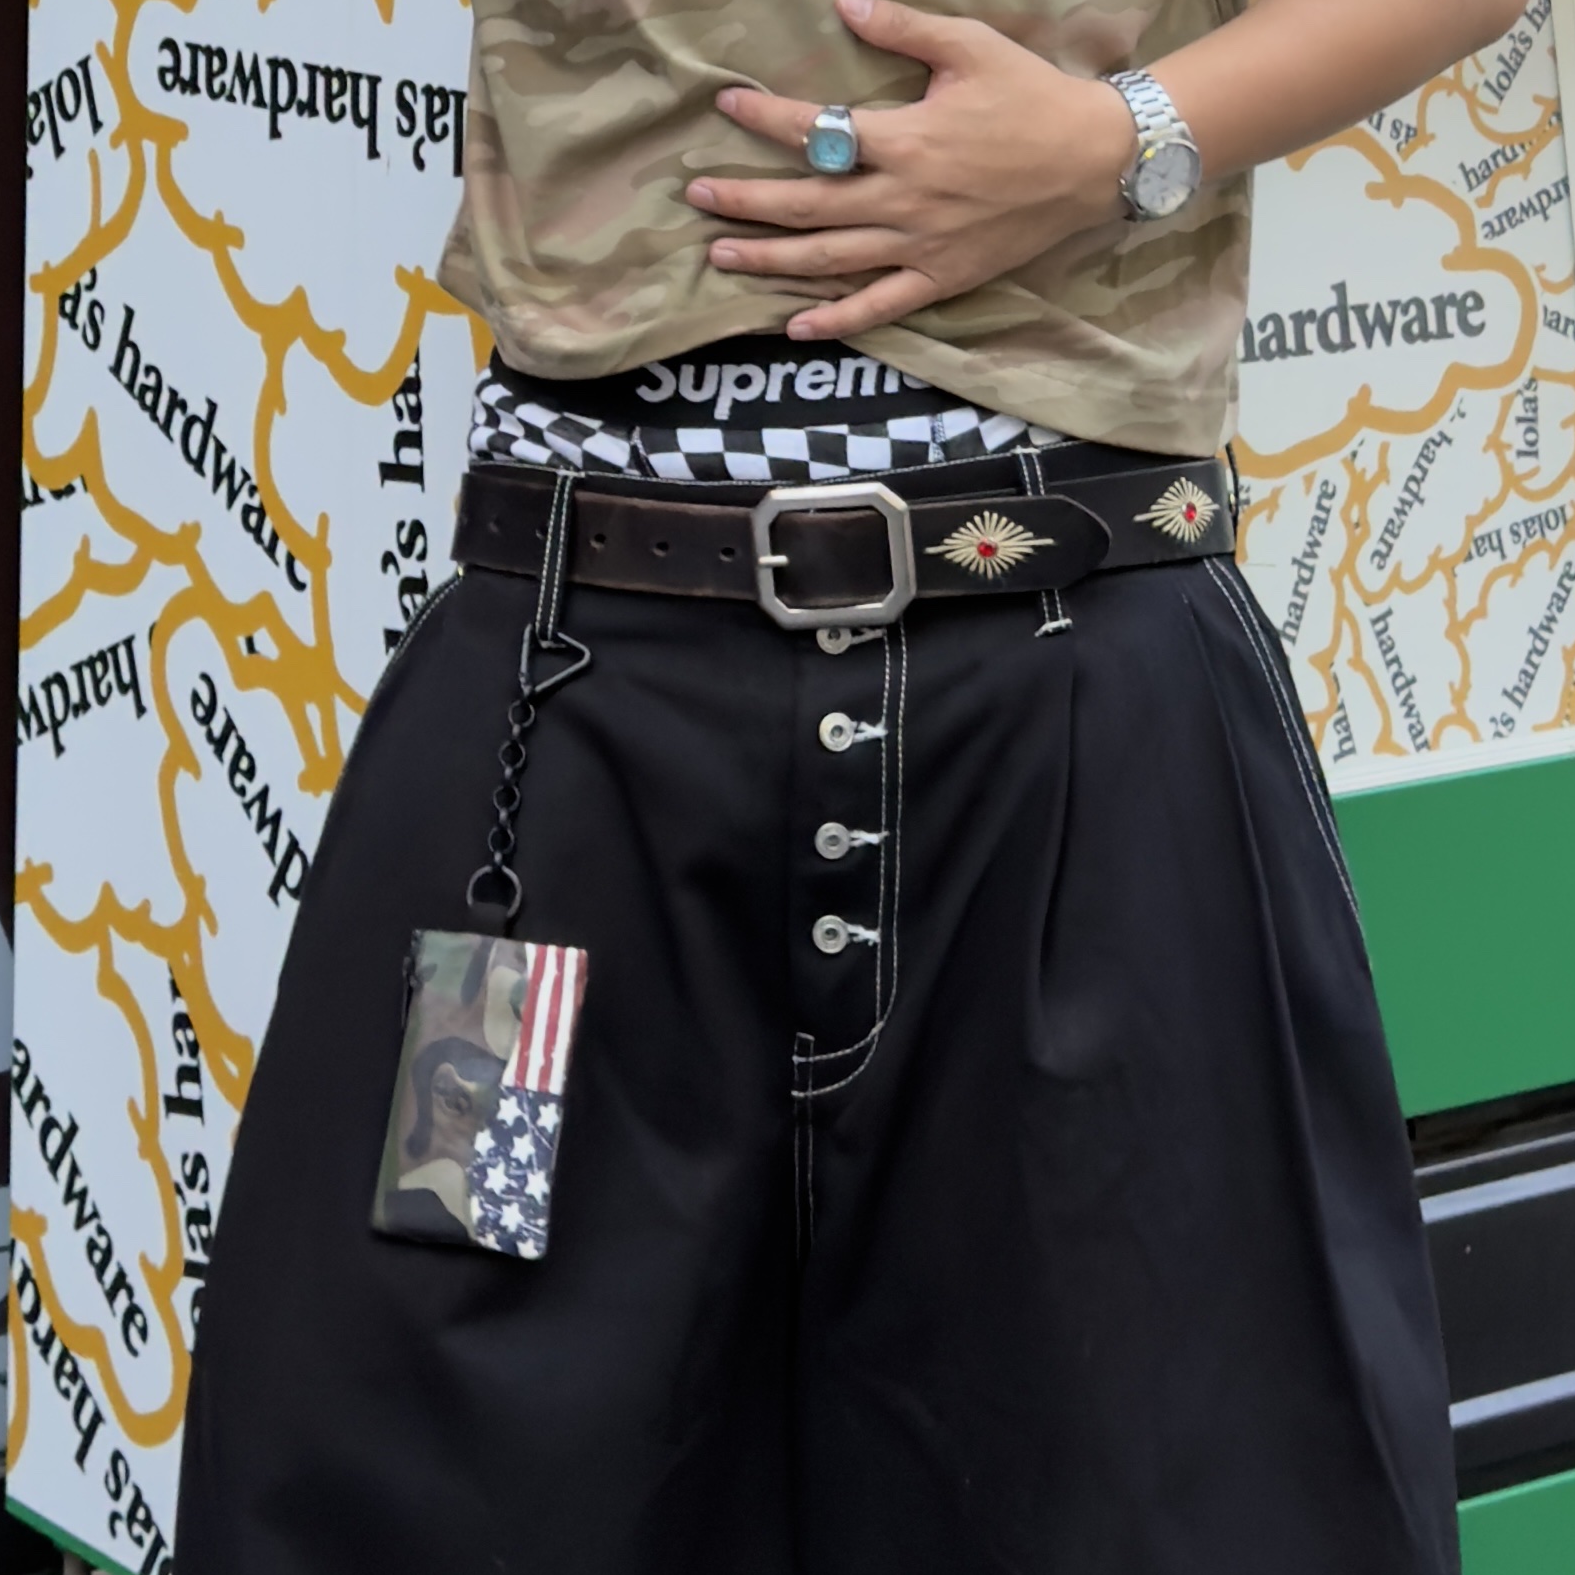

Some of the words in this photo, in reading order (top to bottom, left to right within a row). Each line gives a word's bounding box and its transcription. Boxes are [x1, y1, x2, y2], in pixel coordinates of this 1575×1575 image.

[156, 36, 382, 161] hardware
[1281, 477, 1338, 648] hardware
[1369, 429, 1454, 572] hardware
